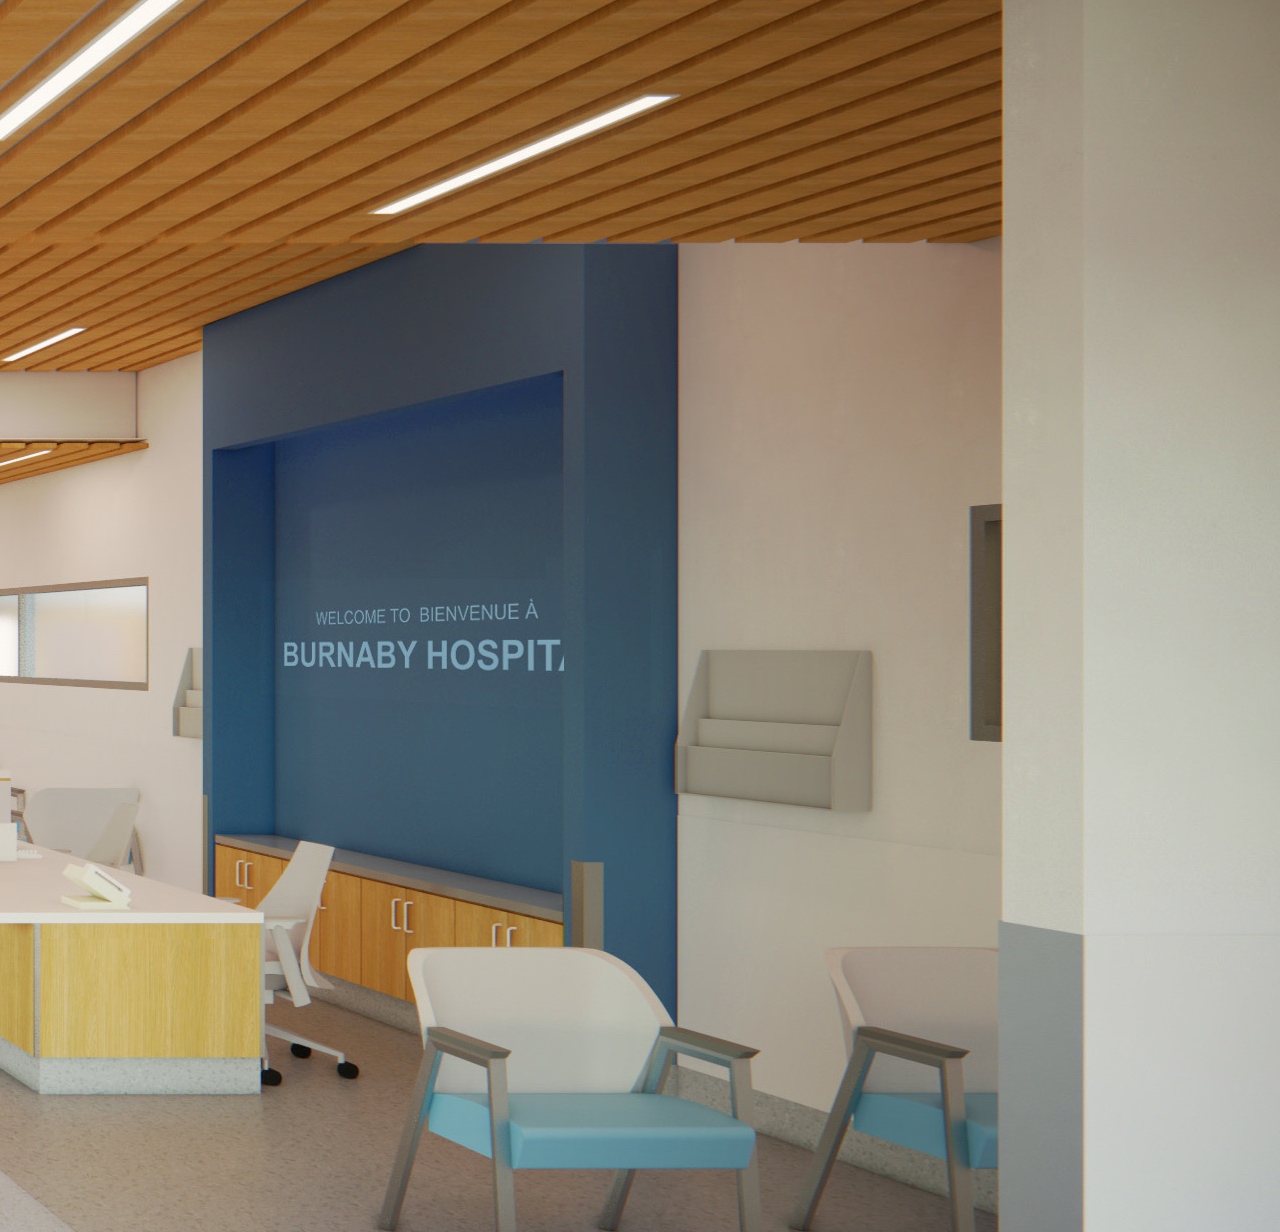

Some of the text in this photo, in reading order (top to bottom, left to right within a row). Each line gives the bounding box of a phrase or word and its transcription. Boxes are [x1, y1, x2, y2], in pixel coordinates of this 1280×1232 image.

[316, 598, 539, 626] WELCOME TO BIENVENUE À
[283, 640, 418, 670] BURNABY
